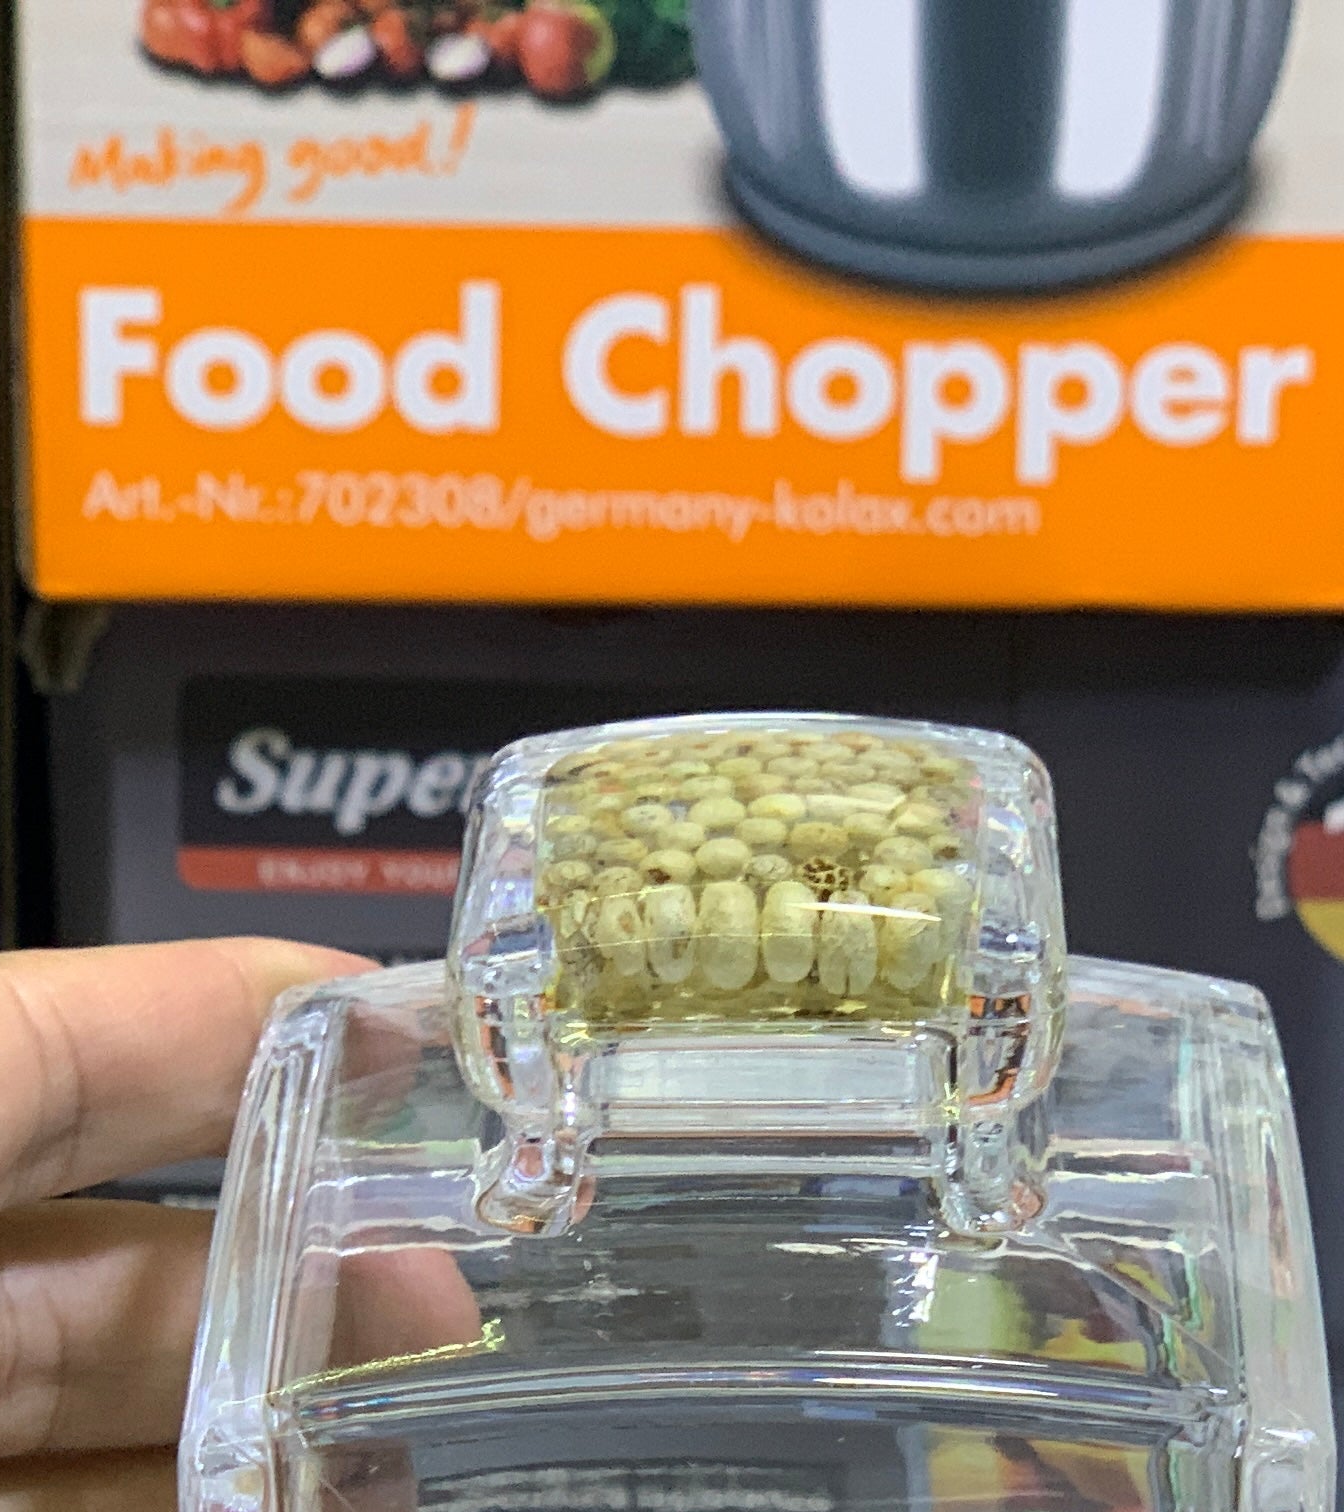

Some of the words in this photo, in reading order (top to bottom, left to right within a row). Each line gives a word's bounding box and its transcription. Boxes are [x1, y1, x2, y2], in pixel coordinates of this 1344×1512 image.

[67, 124, 268, 217] Making
[286, 102, 477, 203] good!
[77, 278, 502, 435] Food
[562, 282, 1314, 487] Chopper
